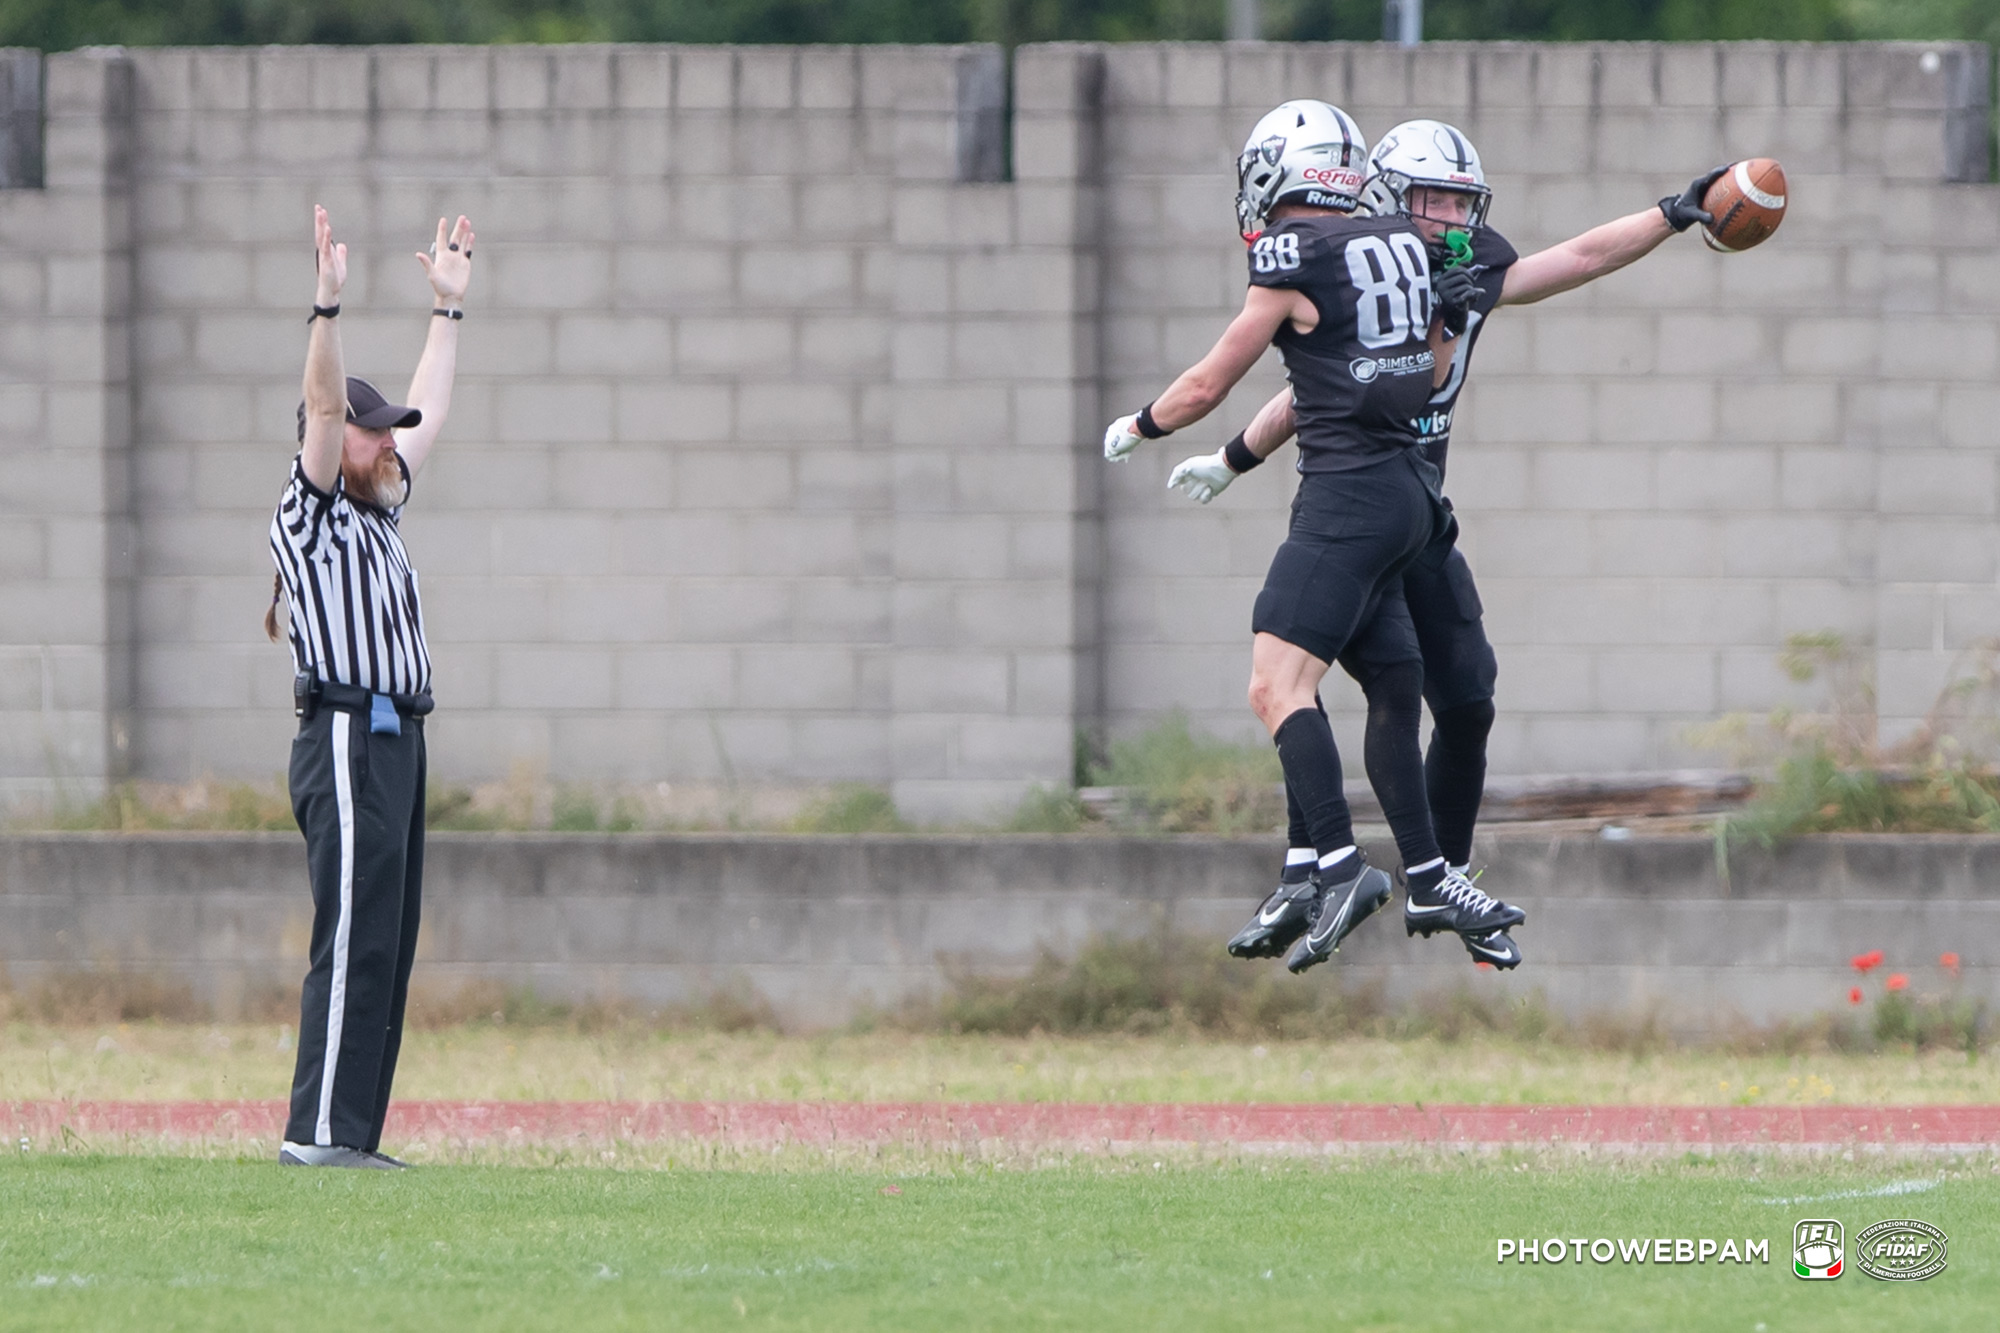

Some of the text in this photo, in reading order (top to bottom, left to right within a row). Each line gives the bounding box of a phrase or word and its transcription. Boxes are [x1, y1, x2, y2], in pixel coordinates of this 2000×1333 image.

[1306, 190, 1357, 209] Riddell
[1252, 232, 1301, 273] 88
[1344, 232, 1432, 350] 88
[1378, 355, 1416, 369] SIMEC
